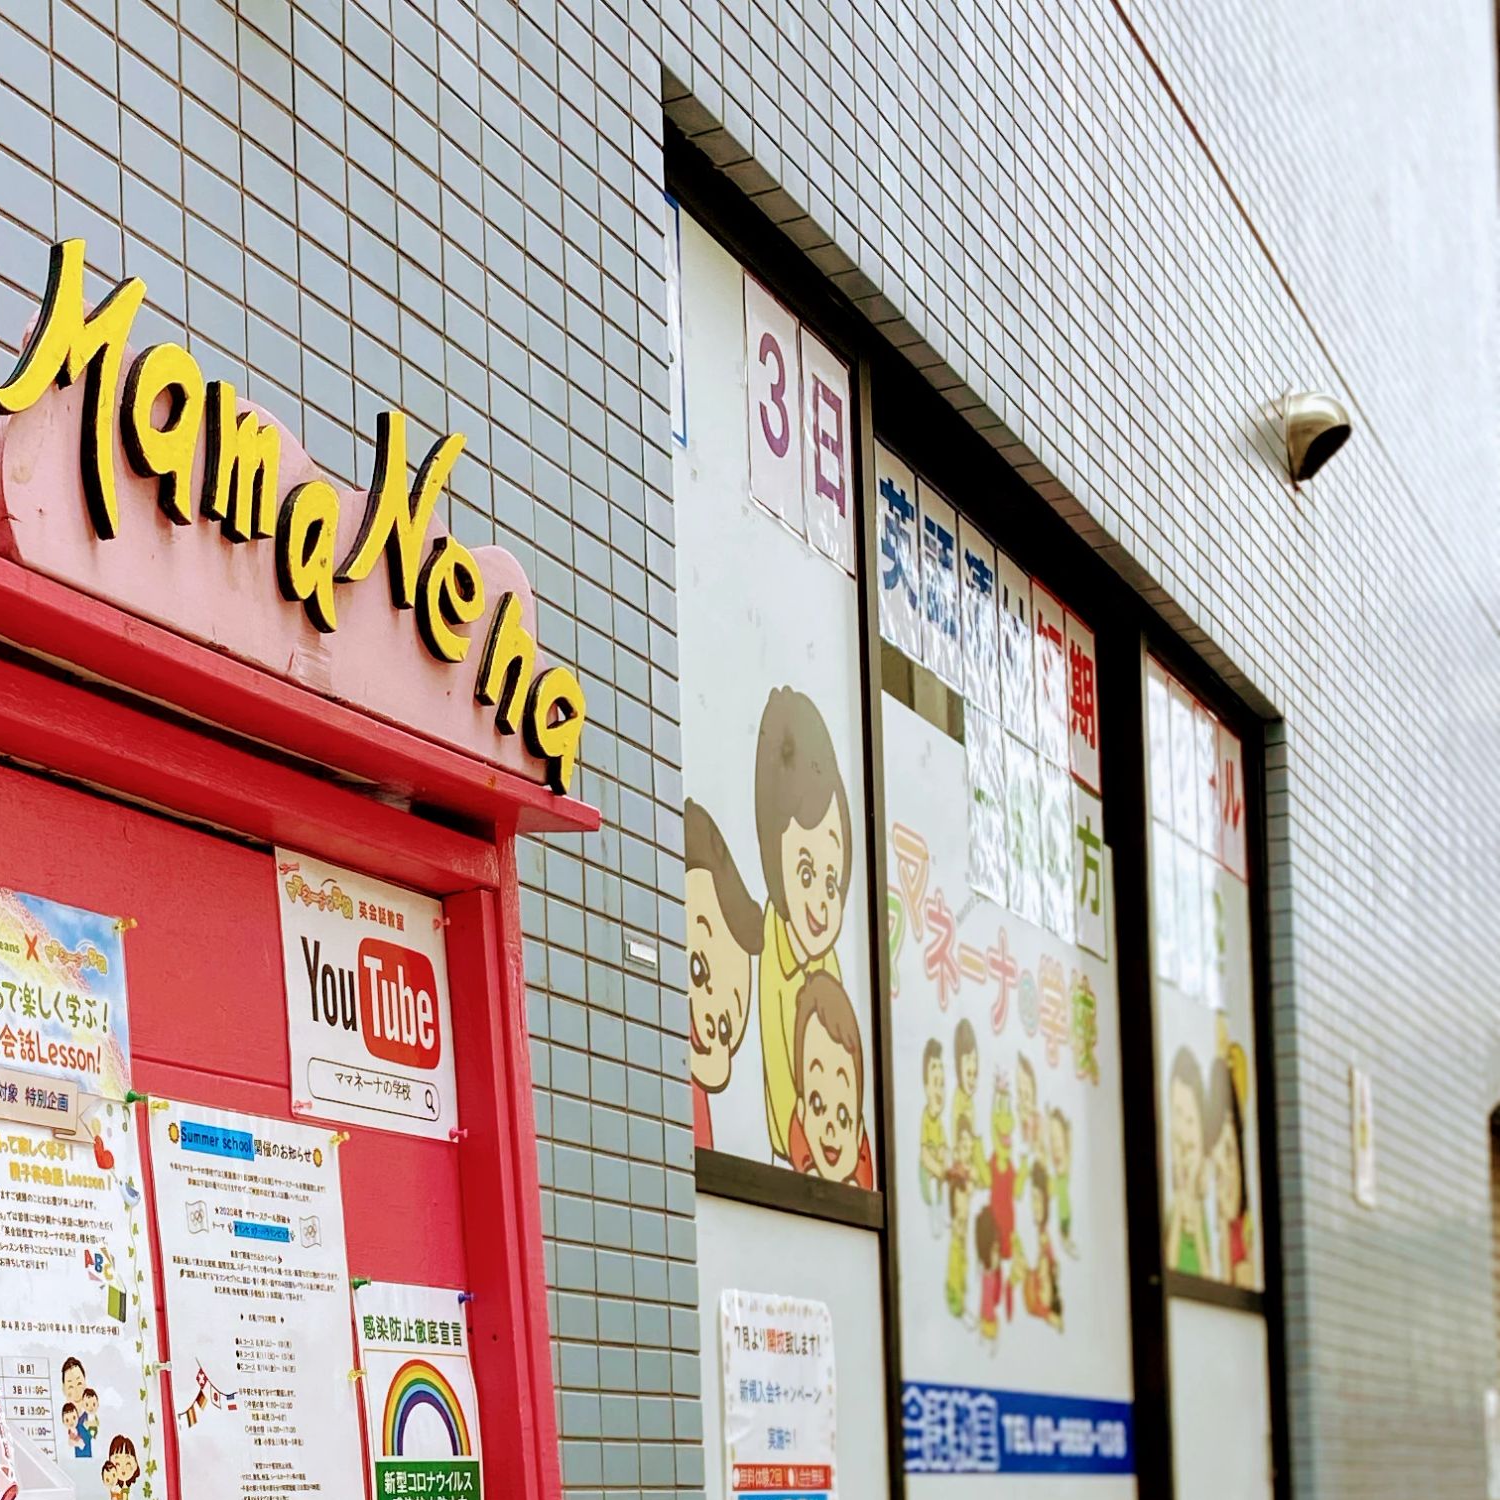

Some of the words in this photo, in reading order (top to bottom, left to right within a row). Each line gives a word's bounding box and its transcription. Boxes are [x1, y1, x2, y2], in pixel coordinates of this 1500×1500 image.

[358, 900, 405, 932] 英会話教室
[300, 936, 435, 1050] YouTube
[25, 1086, 69, 1113] 特別企画
[334, 1071, 411, 1101] ママネーナの学校
[181, 1127, 219, 1149] Summer
[363, 1315, 462, 1347] 感染防止徹底宣言
[740, 1378, 821, 1404] 新規入会キャンペーン
[384, 1470, 473, 1495] 新型コロナウイルス
